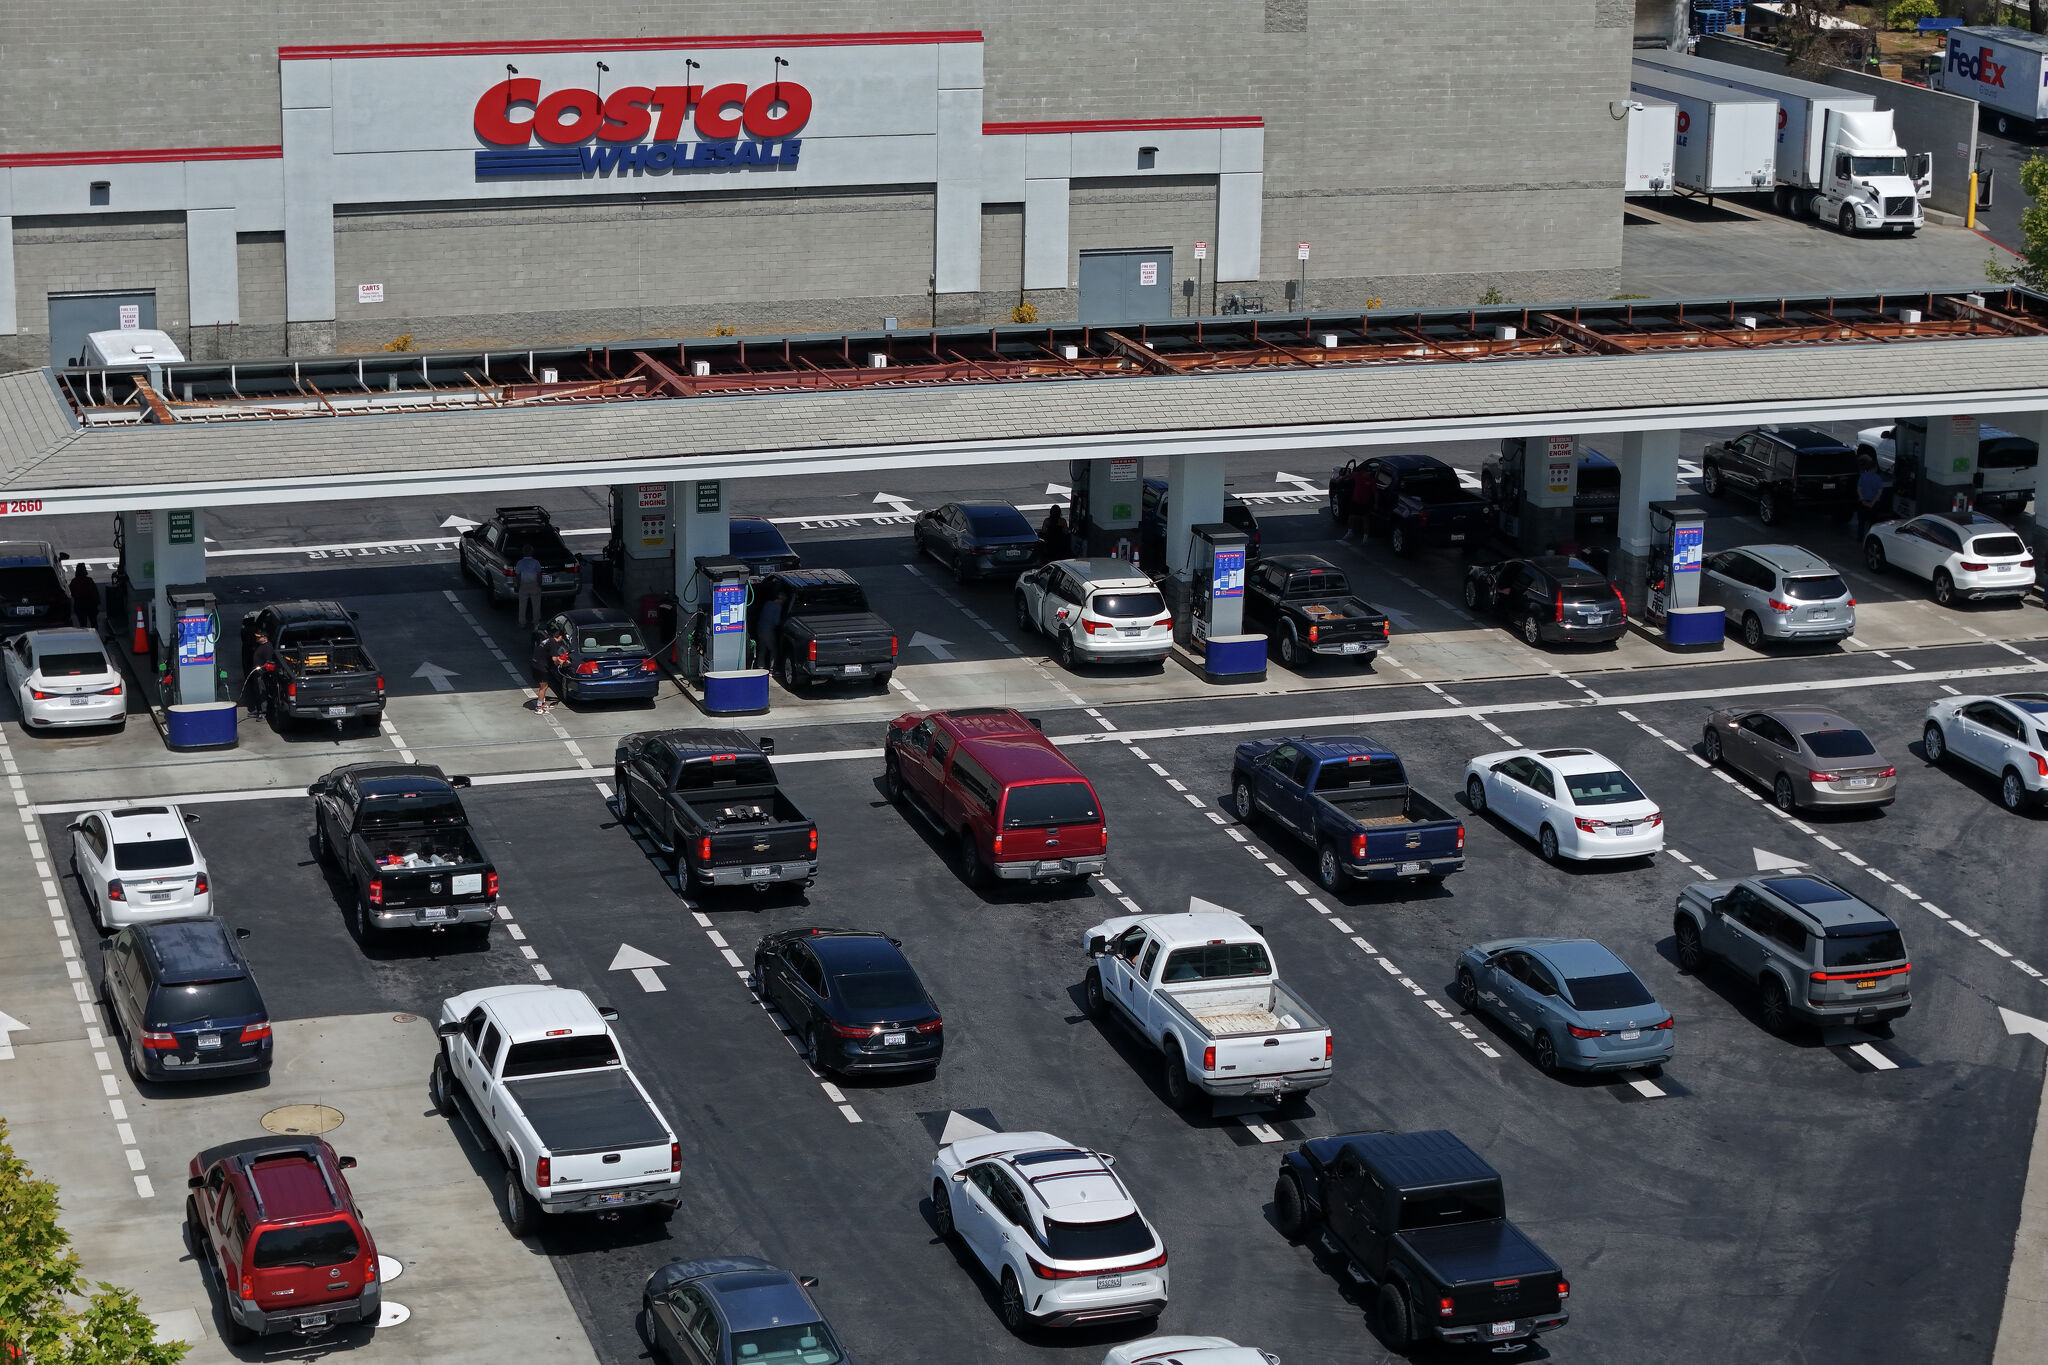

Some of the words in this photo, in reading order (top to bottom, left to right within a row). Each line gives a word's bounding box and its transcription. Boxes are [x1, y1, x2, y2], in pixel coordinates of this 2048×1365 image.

[1948, 38, 2006, 88] FedEx
[474, 78, 812, 145] COSTCO
[579, 140, 802, 173] WHOLESALE
[11, 499, 42, 512] 2660
[306, 545, 422, 559] ENTER
